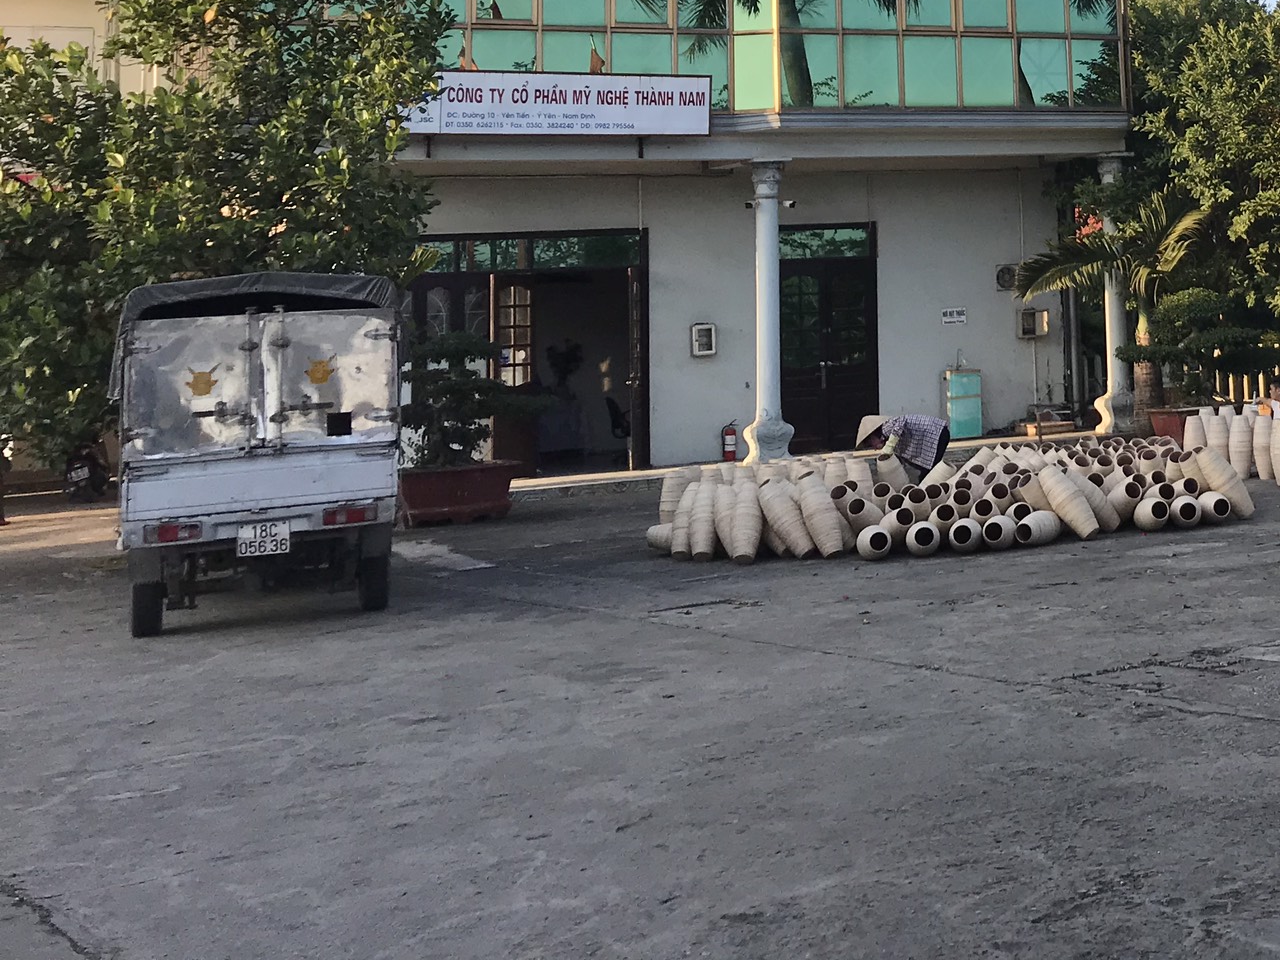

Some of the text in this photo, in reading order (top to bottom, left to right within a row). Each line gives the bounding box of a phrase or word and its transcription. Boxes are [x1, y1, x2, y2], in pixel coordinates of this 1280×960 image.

[448, 81, 706, 109] CÔNG TY CỔ PHẦN MỸ NGHỆ THÀNH NAM
[252, 523, 278, 539] 18C
[239, 538, 288, 554] 056.36
